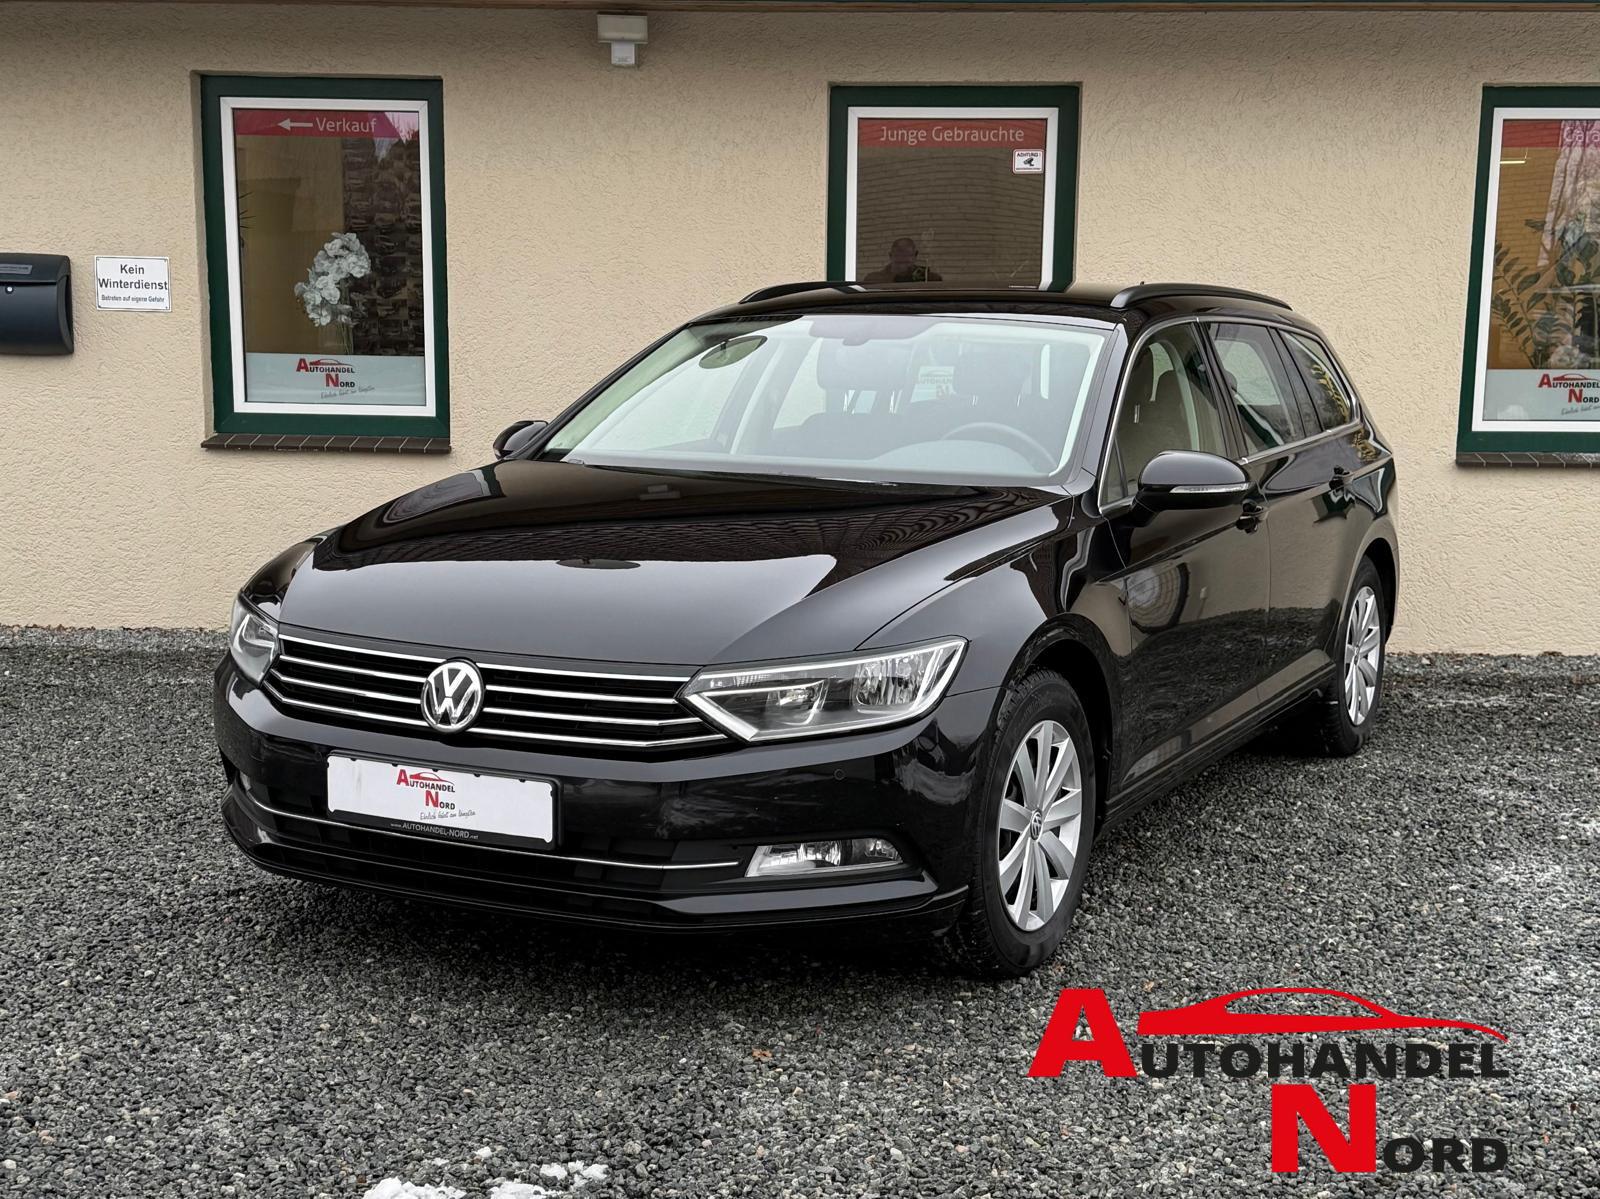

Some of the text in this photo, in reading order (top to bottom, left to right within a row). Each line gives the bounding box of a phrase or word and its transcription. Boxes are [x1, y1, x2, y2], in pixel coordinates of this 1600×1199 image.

[315, 117, 377, 133] Verkauf
[880, 126, 1025, 145] Junge Gebrauchte
[120, 264, 145, 275] Kein
[98, 278, 168, 290] Winterdienst
[296, 358, 355, 373] AUTOHANDEL
[325, 374, 355, 387] NORD
[1538, 373, 1600, 389] AUTOHANDEL
[1568, 389, 1600, 403] NORD
[424, 661, 481, 729] VW
[397, 769, 455, 792] AUTOHANDEL
[425, 790, 455, 810] NORD
